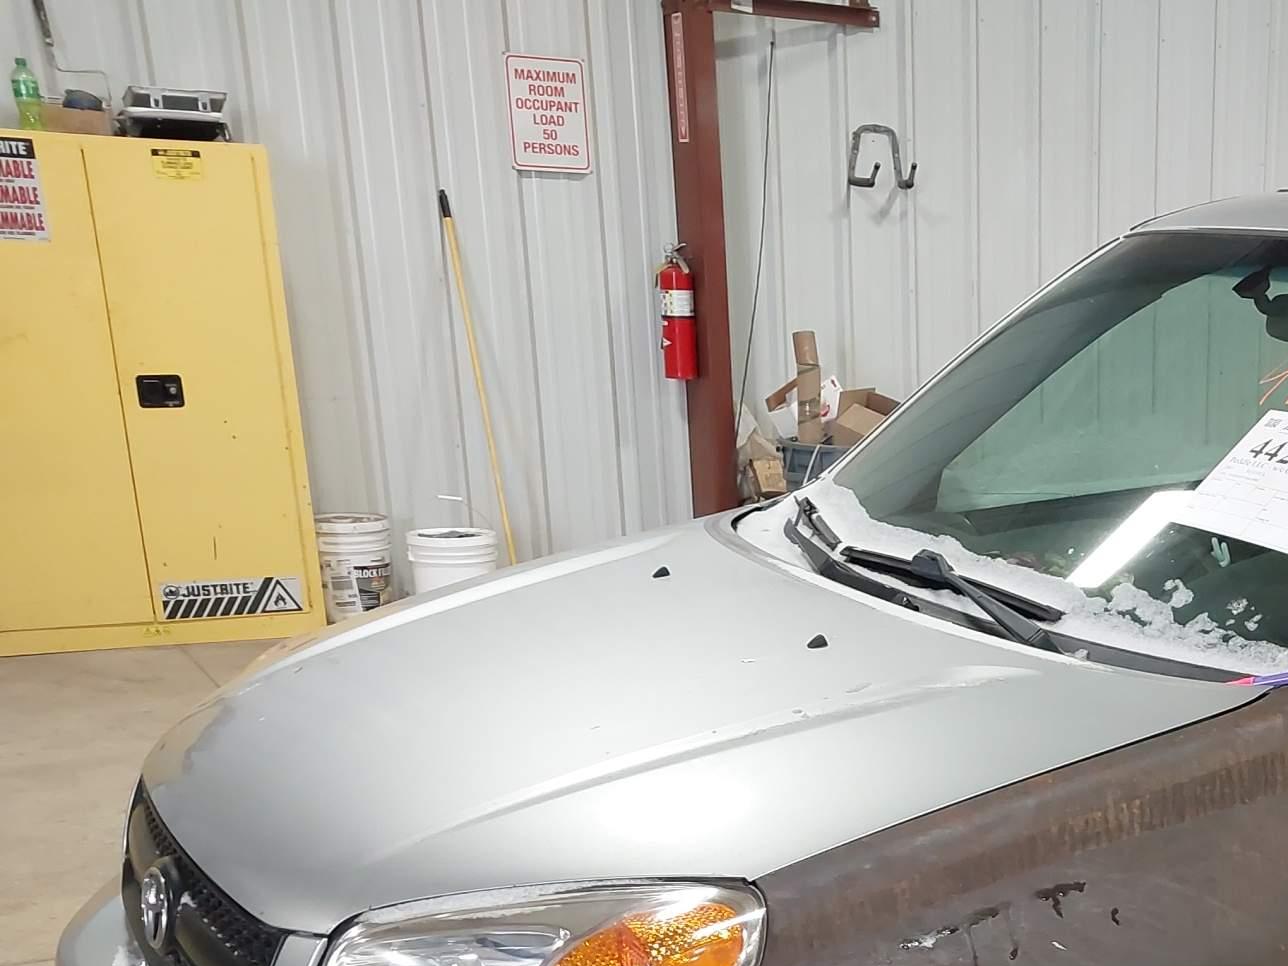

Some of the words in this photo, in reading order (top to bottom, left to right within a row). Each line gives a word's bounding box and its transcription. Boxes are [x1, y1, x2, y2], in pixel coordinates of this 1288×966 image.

[514, 68, 577, 84] MAXIMUM
[528, 84, 565, 97] ROOM
[515, 98, 579, 113] OCCUPANT
[533, 113, 564, 126] LOAD
[543, 129, 558, 141] 50
[523, 142, 579, 156] PERSONS
[182, 583, 249, 597] JUSTRITE
